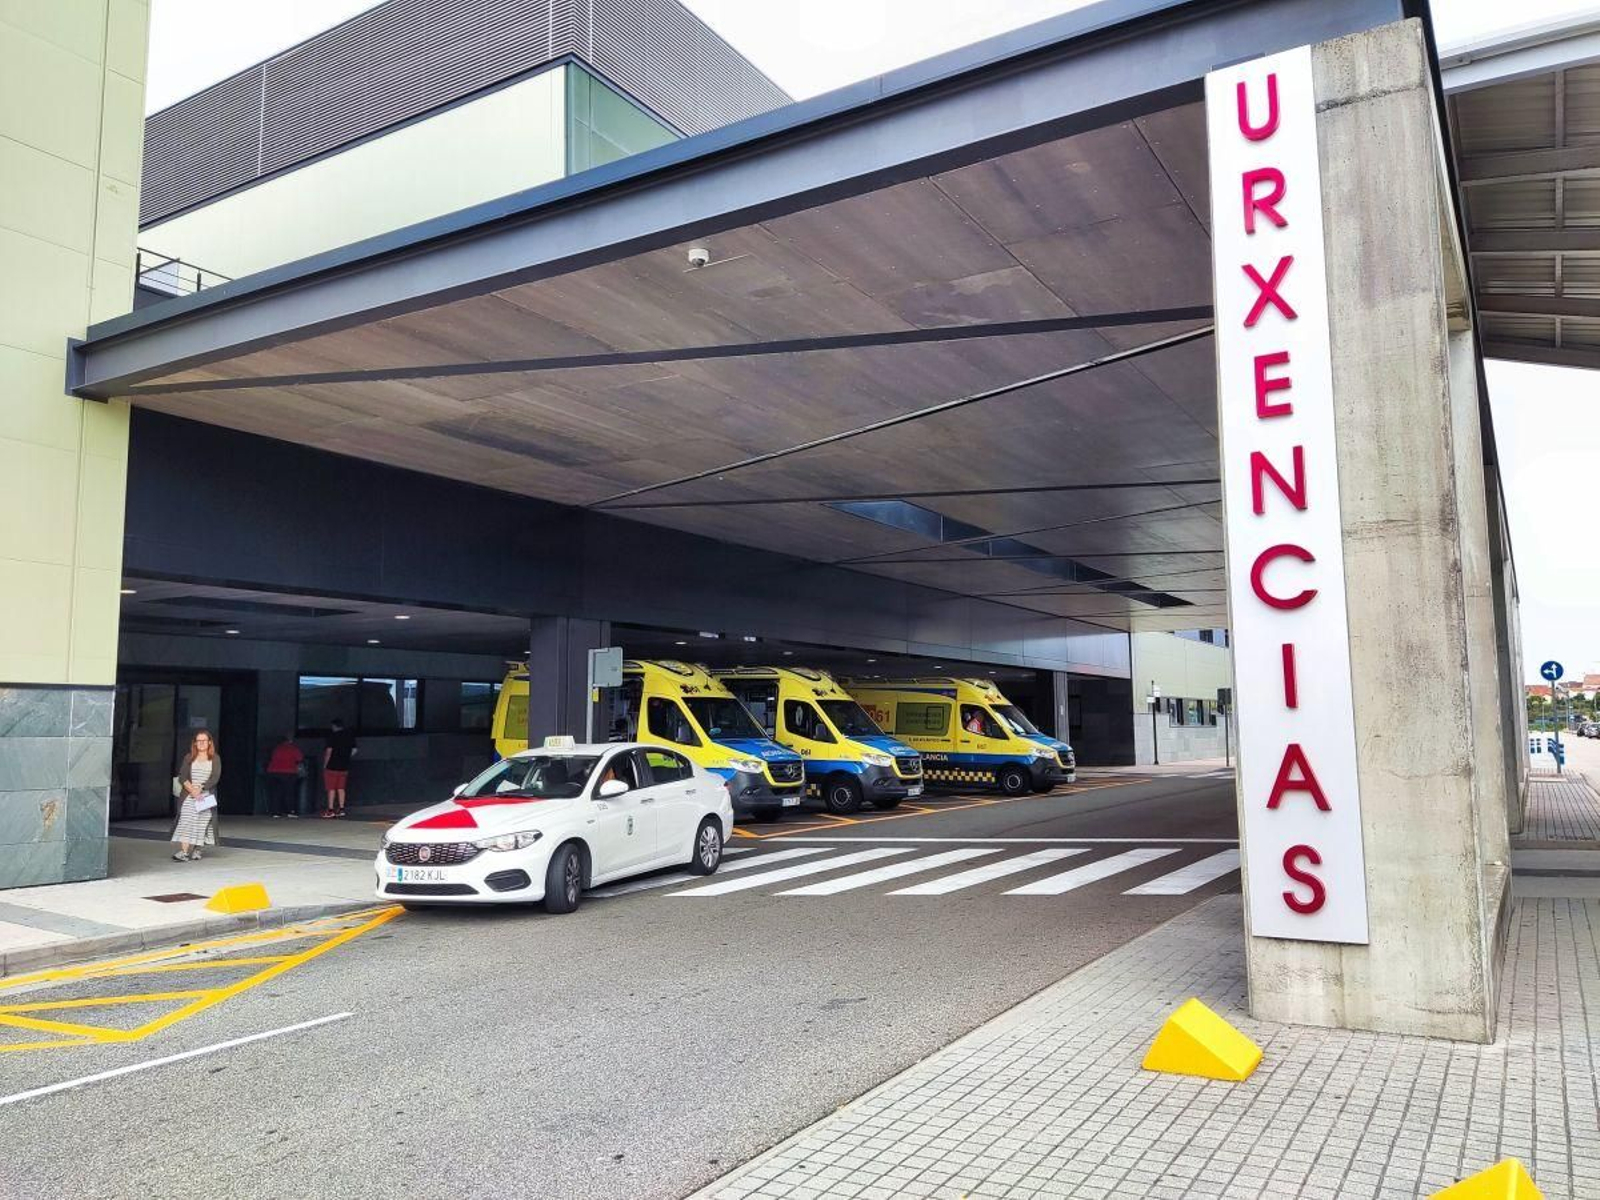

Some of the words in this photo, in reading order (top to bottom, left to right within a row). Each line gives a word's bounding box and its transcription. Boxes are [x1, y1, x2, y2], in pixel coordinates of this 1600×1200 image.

[1236, 73, 1332, 915] URXENCIAS
[404, 869, 426, 881] 2182
[427, 869, 445, 881] KJL
